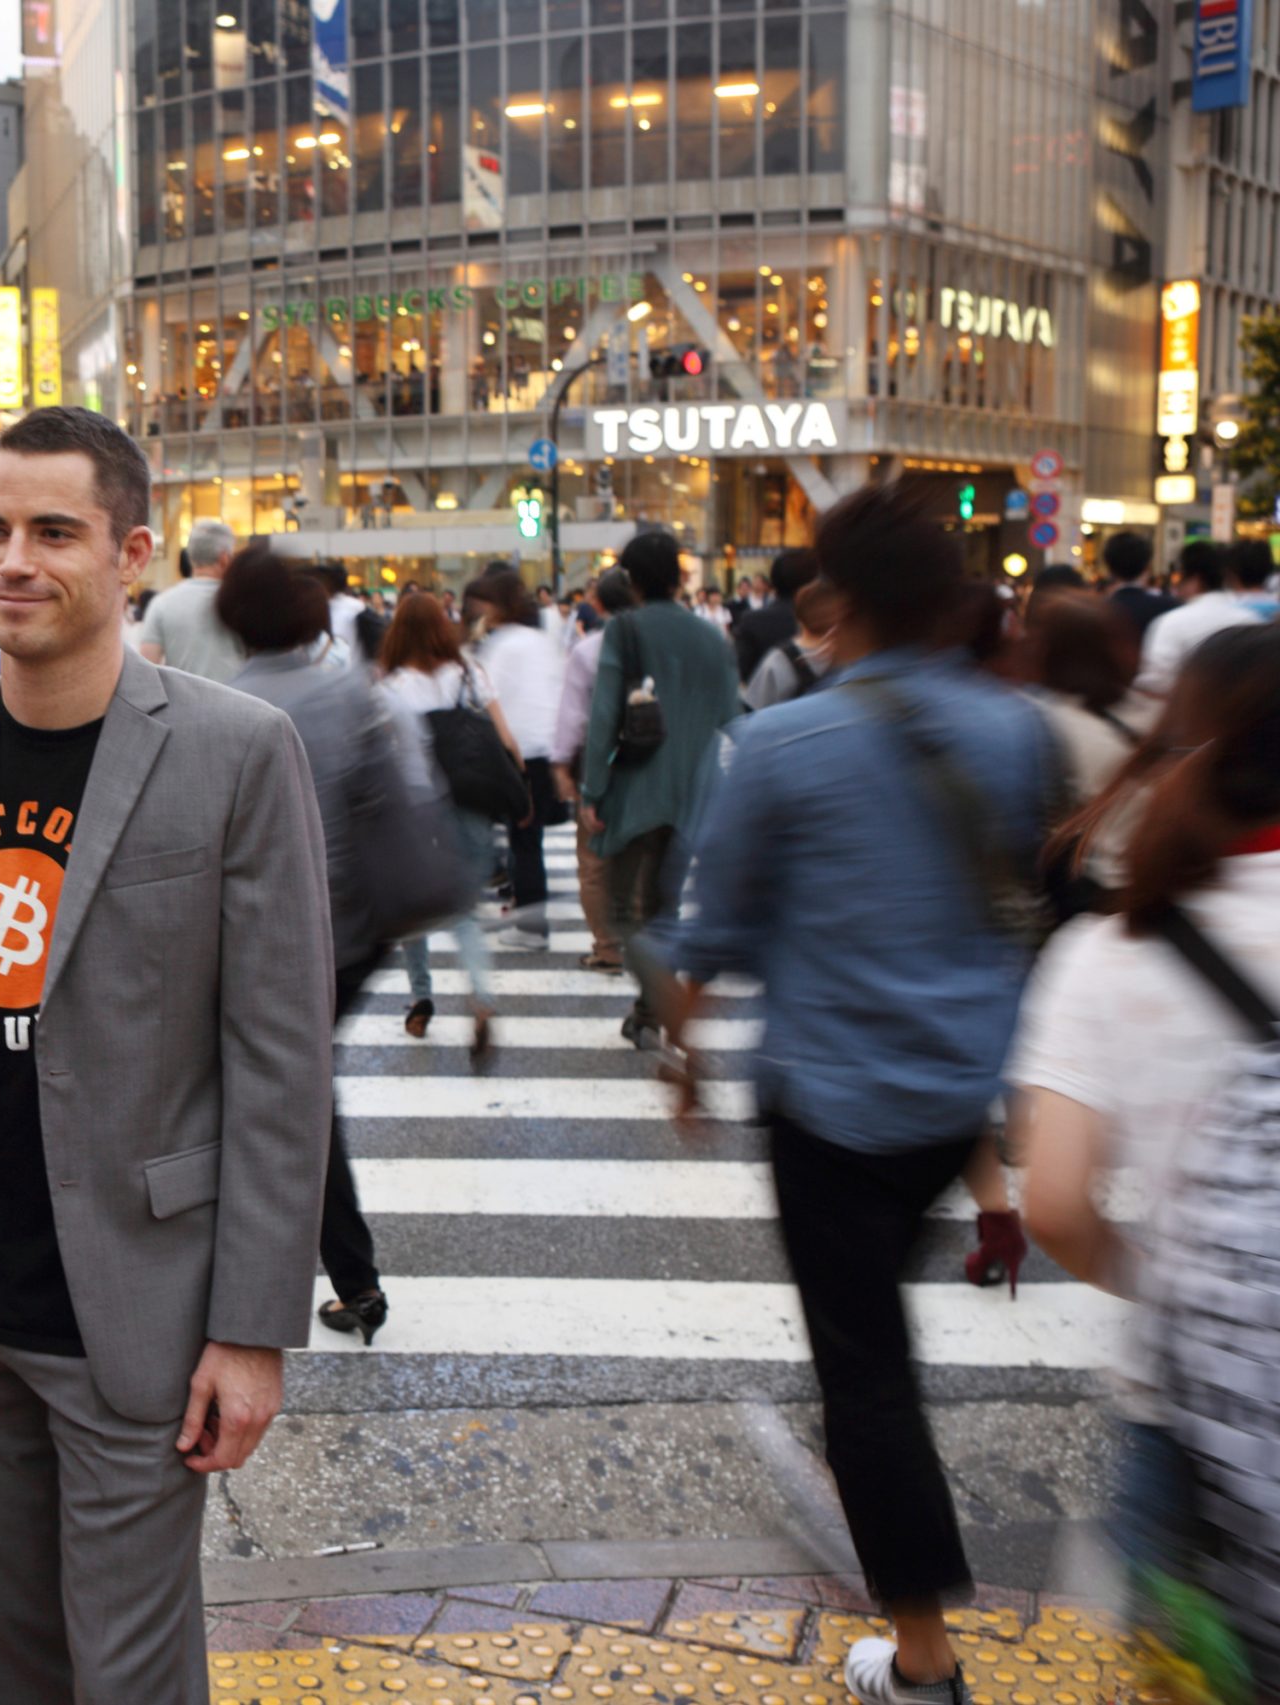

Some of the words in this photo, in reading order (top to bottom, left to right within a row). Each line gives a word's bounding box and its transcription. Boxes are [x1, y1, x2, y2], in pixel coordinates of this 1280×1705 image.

[261, 285, 476, 331] STARBUCKS
[496, 272, 648, 309] COFFEE
[593, 402, 837, 453] TSUTAYA
